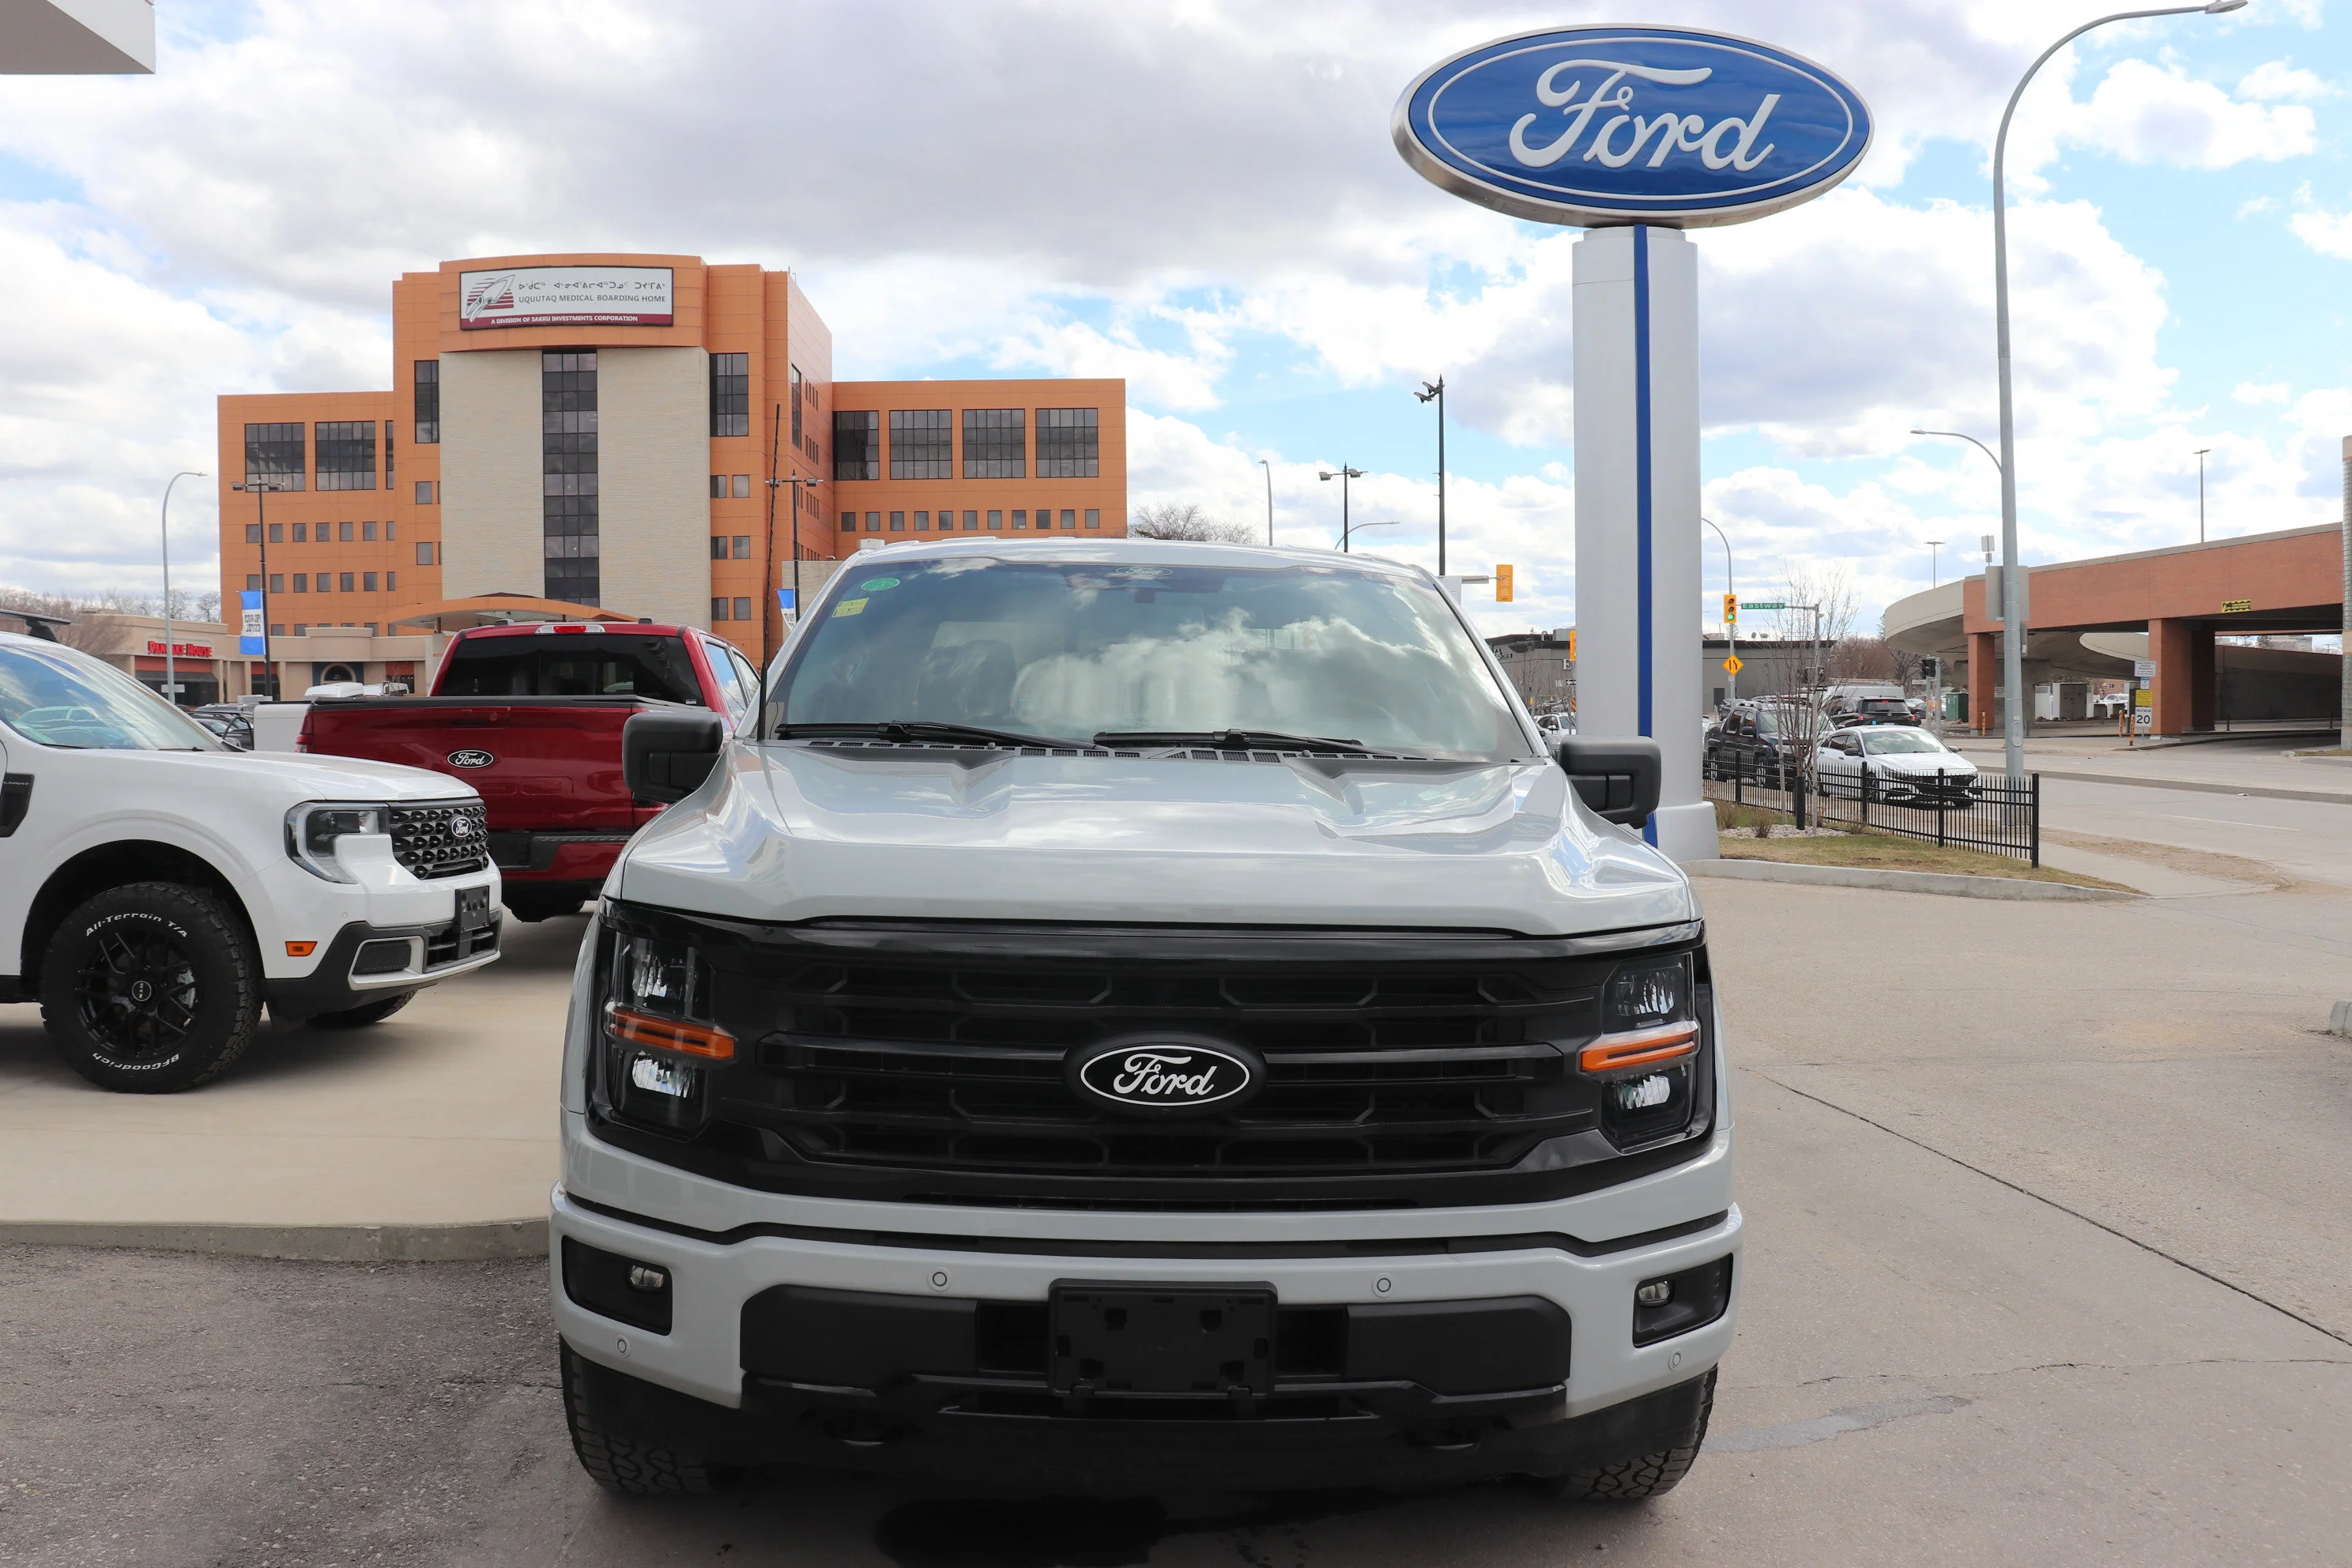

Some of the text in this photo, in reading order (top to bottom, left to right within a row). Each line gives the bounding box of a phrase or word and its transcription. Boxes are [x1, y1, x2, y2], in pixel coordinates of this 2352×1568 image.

[1509, 58, 1781, 172] Ford
[518, 295, 557, 303] UQUUTAQ
[148, 641, 213, 658] PANAKE HOUSE
[2136, 714, 2150, 724] 20
[455, 752, 484, 765] Ford
[456, 820, 469, 834] Ford
[86, 912, 187, 938] All-Terrain T/A
[92, 1053, 179, 1070] BFGoodrich
[1114, 1053, 1218, 1095] Ford
